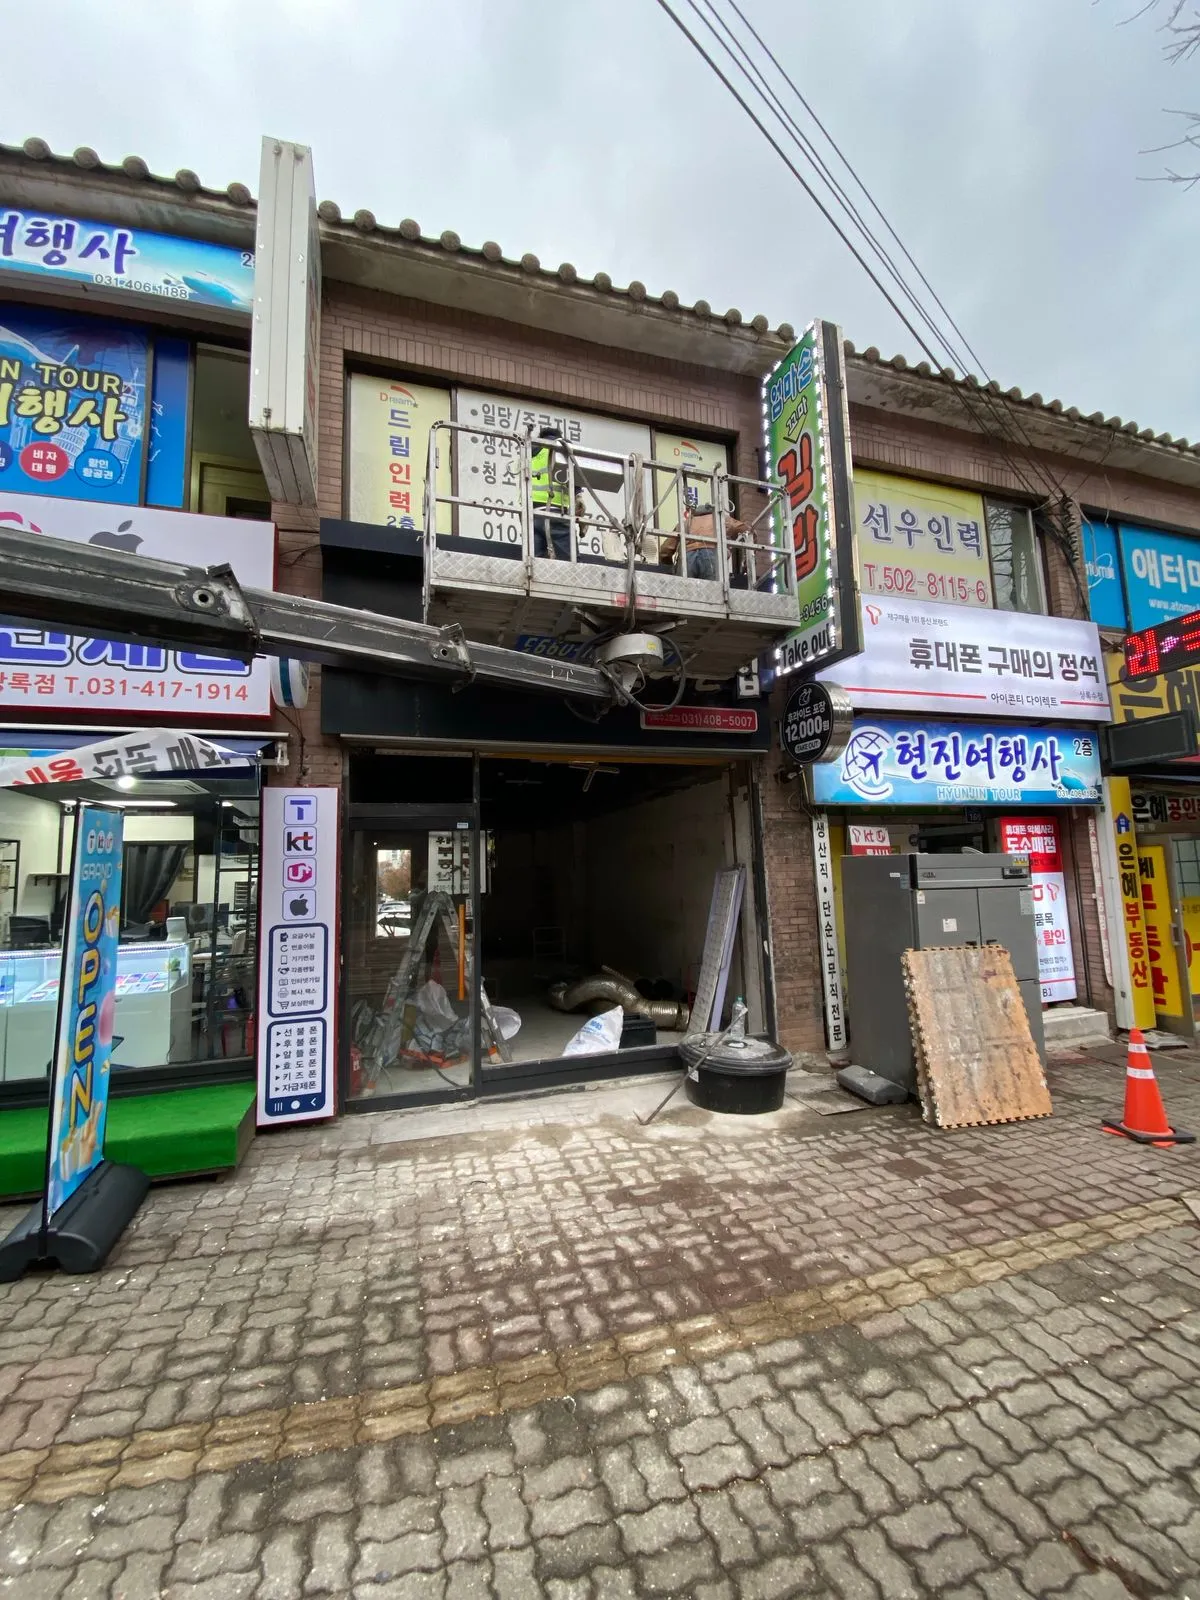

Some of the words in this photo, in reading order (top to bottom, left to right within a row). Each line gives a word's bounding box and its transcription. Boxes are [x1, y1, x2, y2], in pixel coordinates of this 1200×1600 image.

[38, 363, 122, 395] TOUR
[862, 503, 982, 557] 선우인력
[781, 639, 809, 668] Take
[908, 637, 983, 674] 휴대폰
[987, 645, 1054, 680] 구매의
[1057, 652, 1100, 684] 정석
[64, 676, 250, 701] T.031-417-1914
[787, 706, 812, 724] 후라이드
[812, 701, 826, 715] 포장
[896, 732, 1063, 783] 현진여행사
[1073, 738, 1093, 757] 2층
[937, 787, 988, 800] HYUNJIN
[991, 787, 1021, 800] TOUR
[286, 831, 314, 852] kt
[1006, 836, 1057, 854] 도소매점
[1042, 929, 1066, 946] 할인
[68, 888, 105, 1120] OPEN
